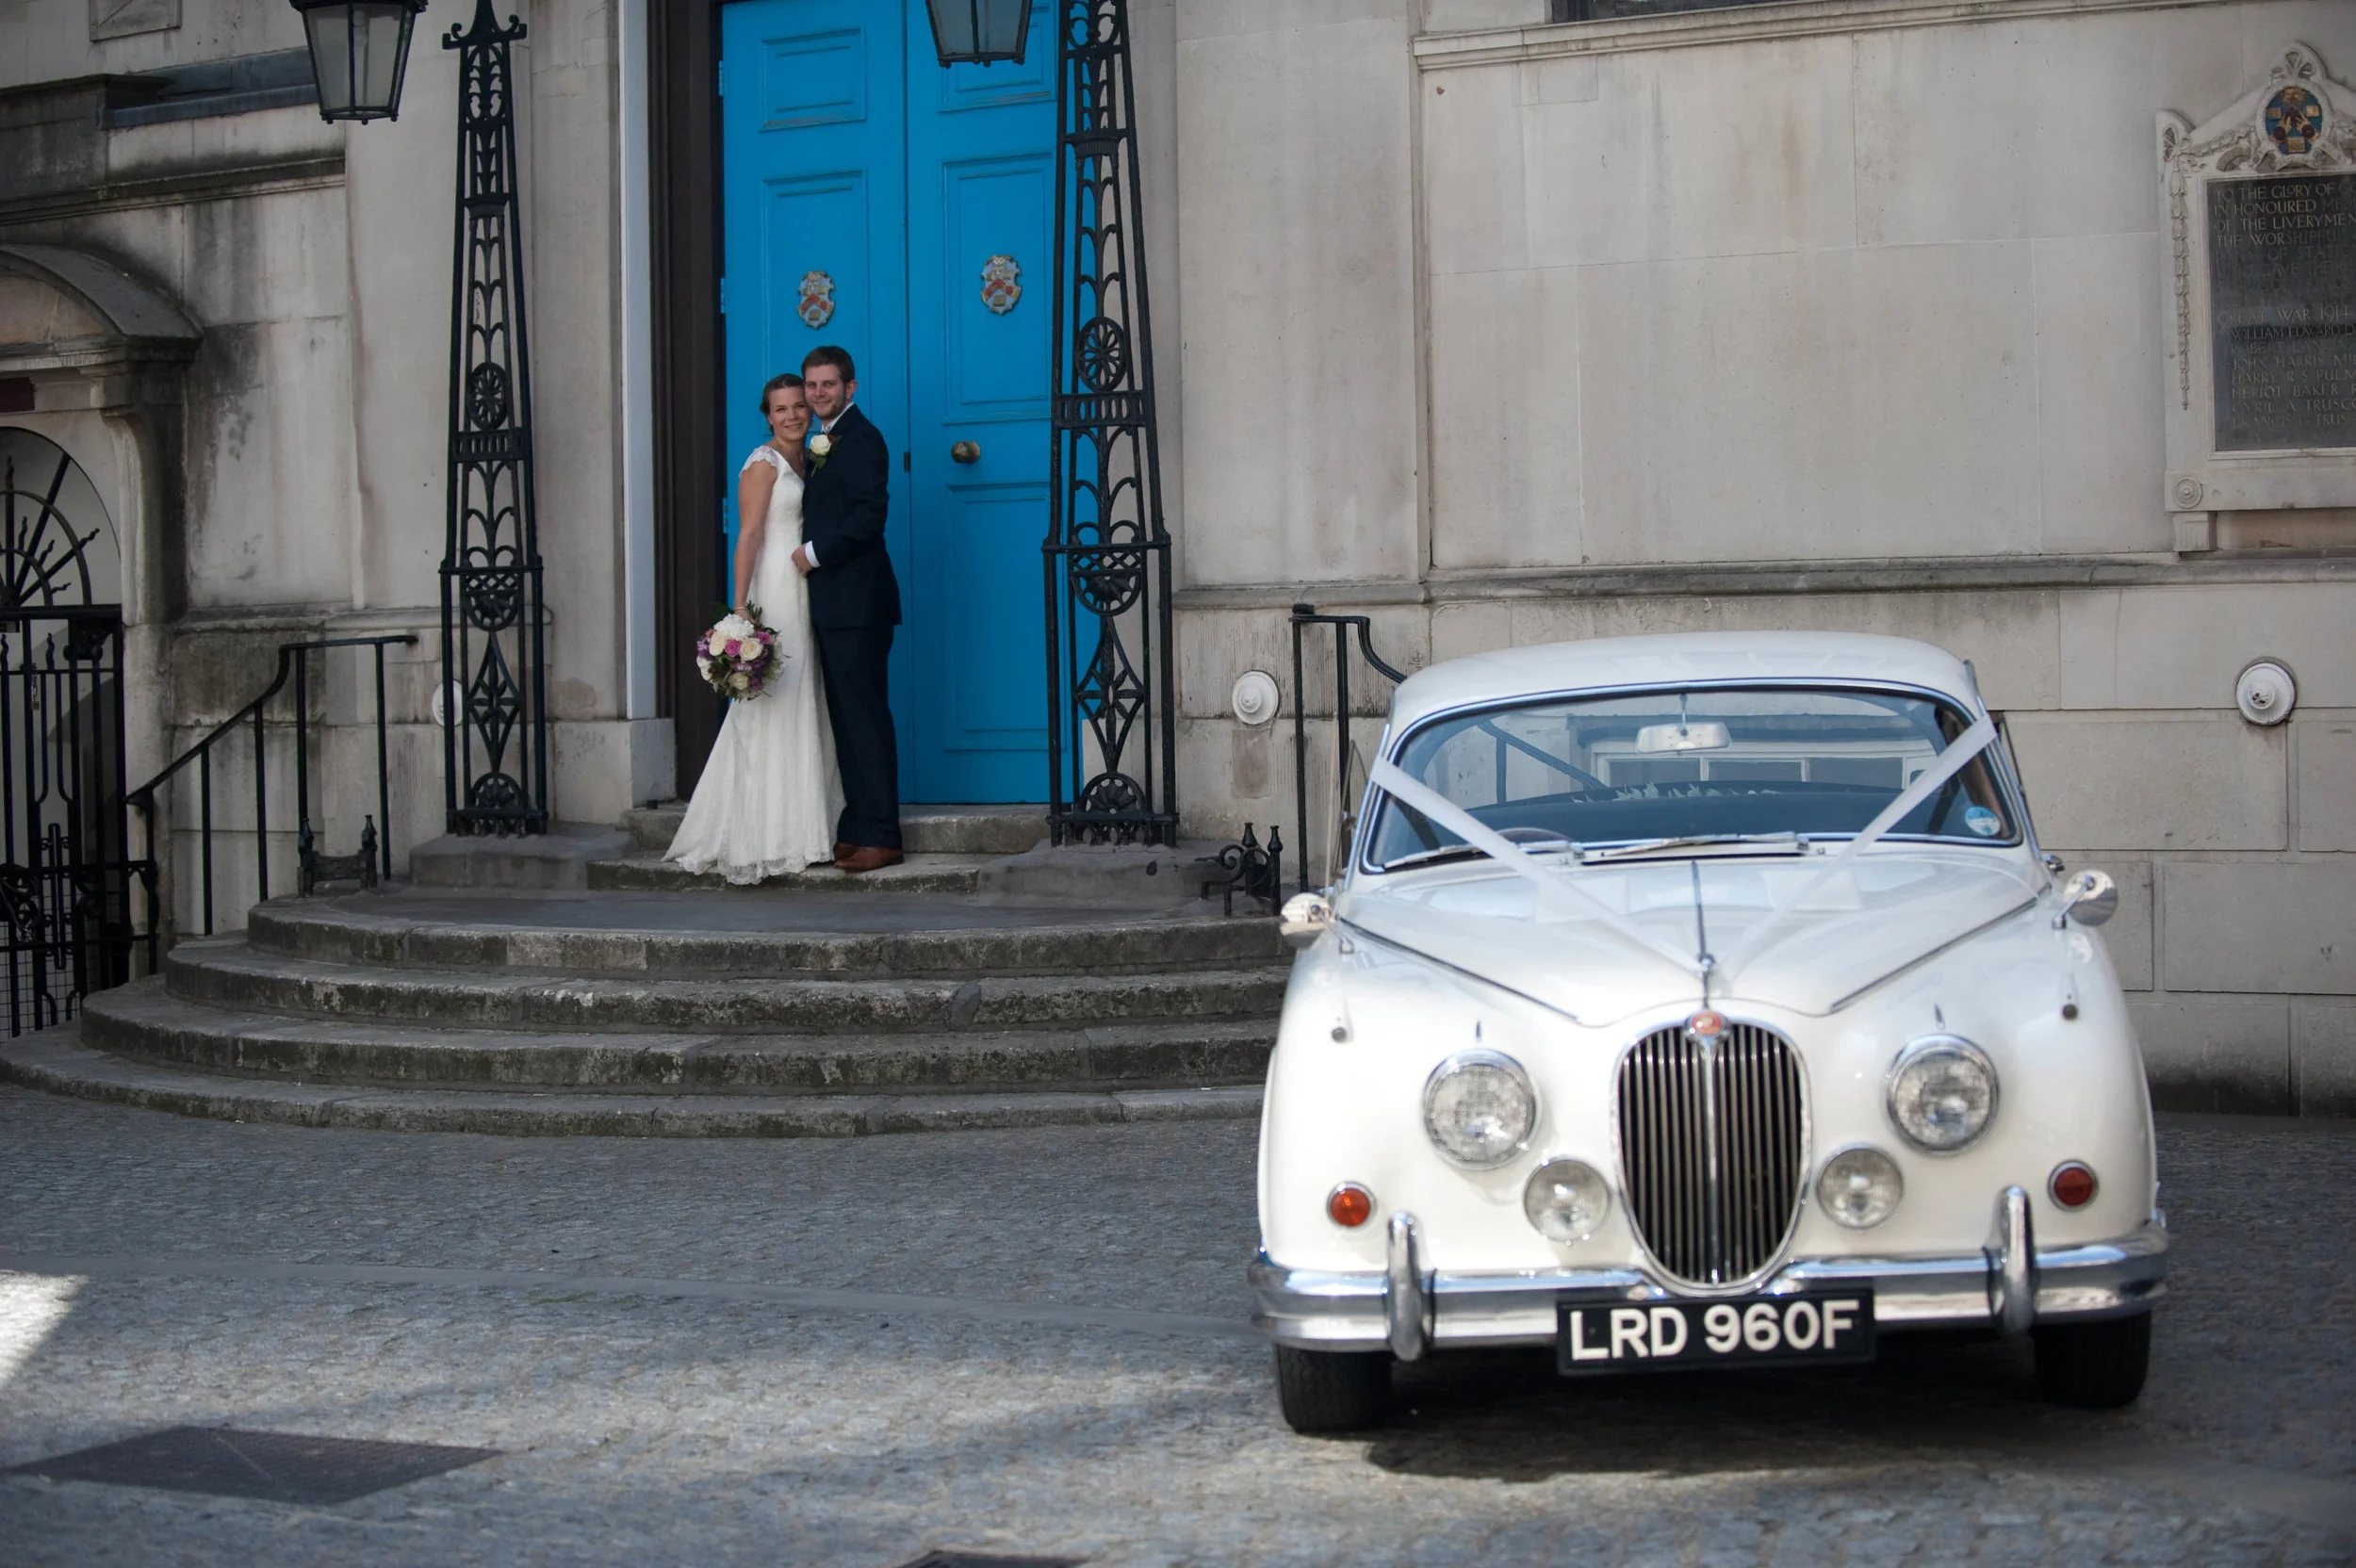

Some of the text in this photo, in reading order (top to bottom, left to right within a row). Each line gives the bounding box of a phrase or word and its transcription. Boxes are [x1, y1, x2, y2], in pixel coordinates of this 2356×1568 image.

[2239, 186, 2266, 200] THE
[2271, 184, 2312, 199] GLORY
[2315, 182, 2335, 196] OF
[2215, 204, 2229, 217] IN
[2233, 199, 2316, 216] HONOURED
[2215, 219, 2233, 232] OF
[2242, 217, 2266, 231] THE
[2217, 235, 2242, 248] THE
[2277, 308, 2311, 322] WAR
[2319, 303, 2350, 321] 1914
[2231, 326, 2283, 340] WILLIAM
[2289, 323, 2340, 338] EDWARD
[1570, 1299, 1859, 1360] LRD 960F
